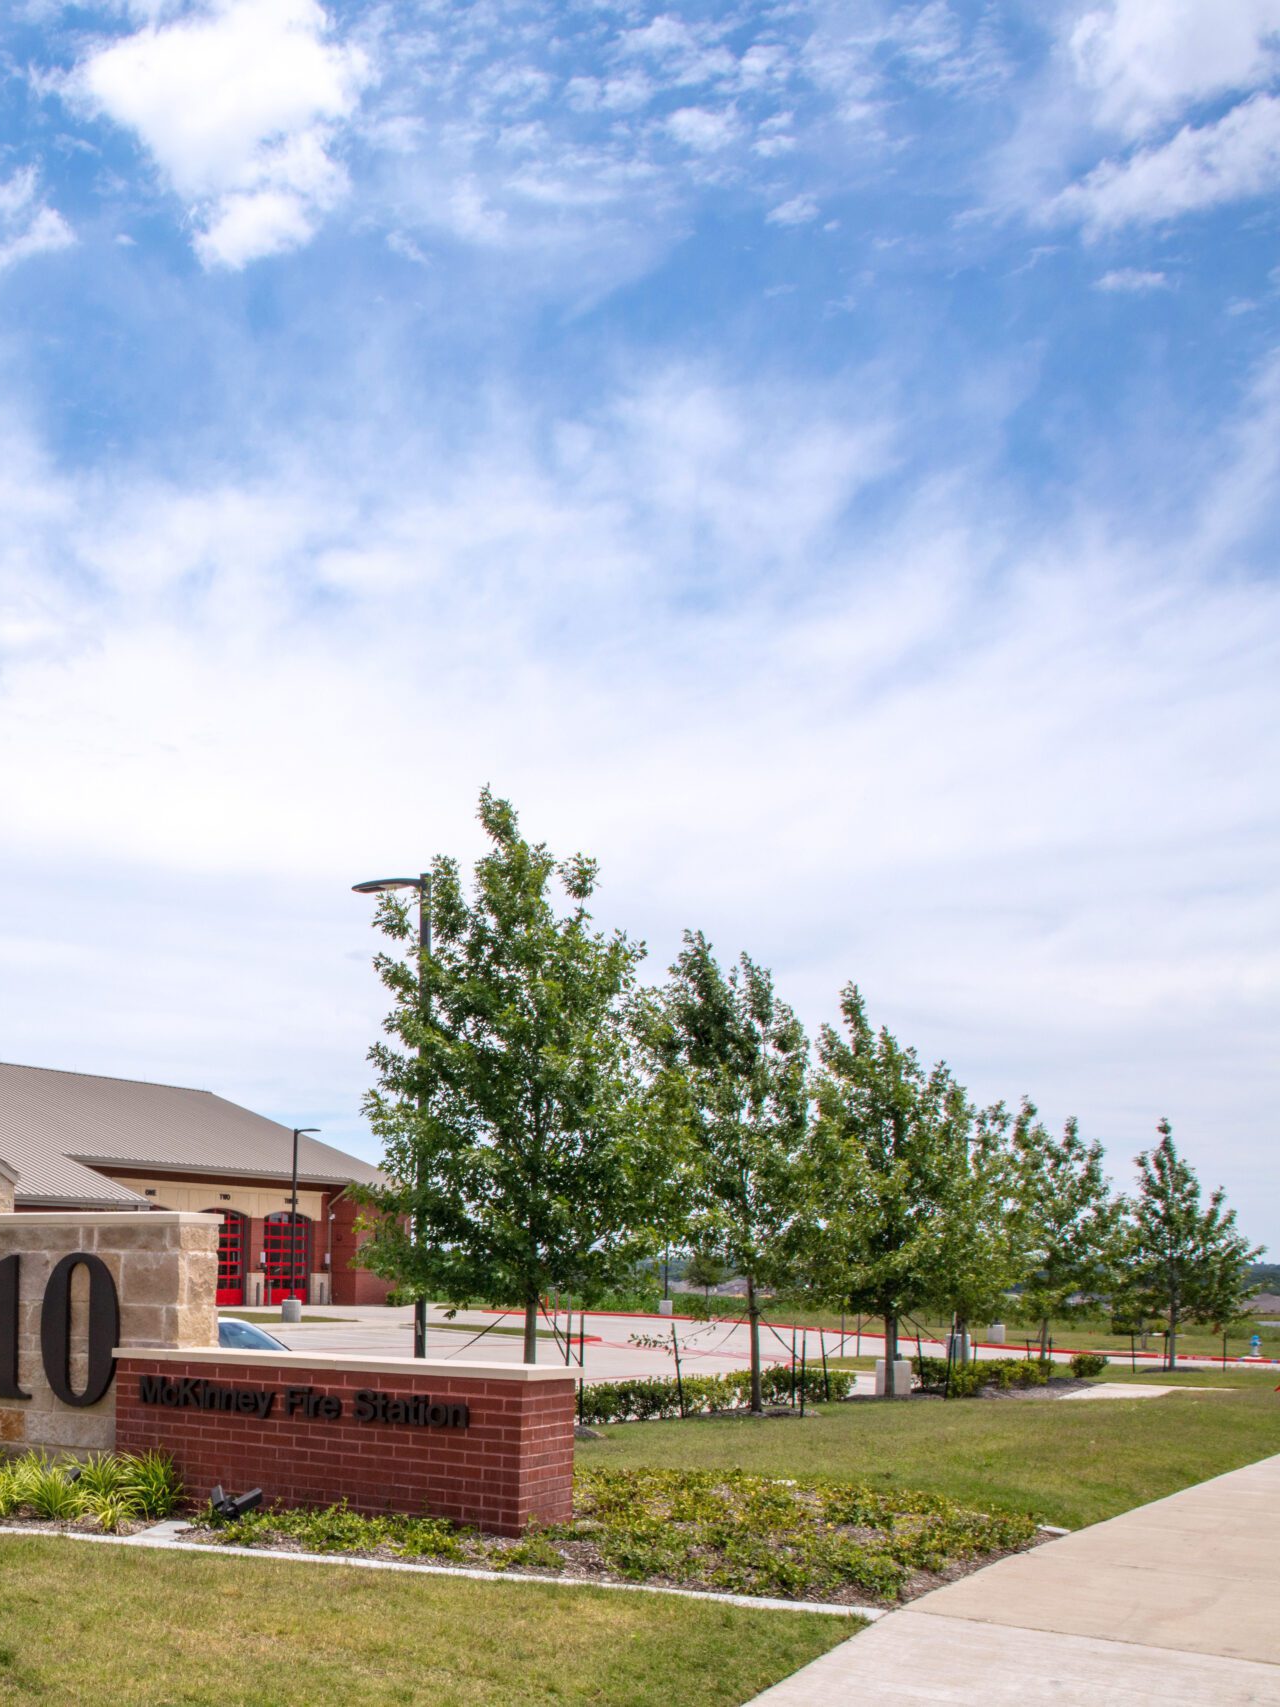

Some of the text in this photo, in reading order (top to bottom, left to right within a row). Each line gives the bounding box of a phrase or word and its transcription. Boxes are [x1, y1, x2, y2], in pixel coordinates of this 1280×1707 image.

[139, 1375, 470, 1428] McKinney Fire Station
